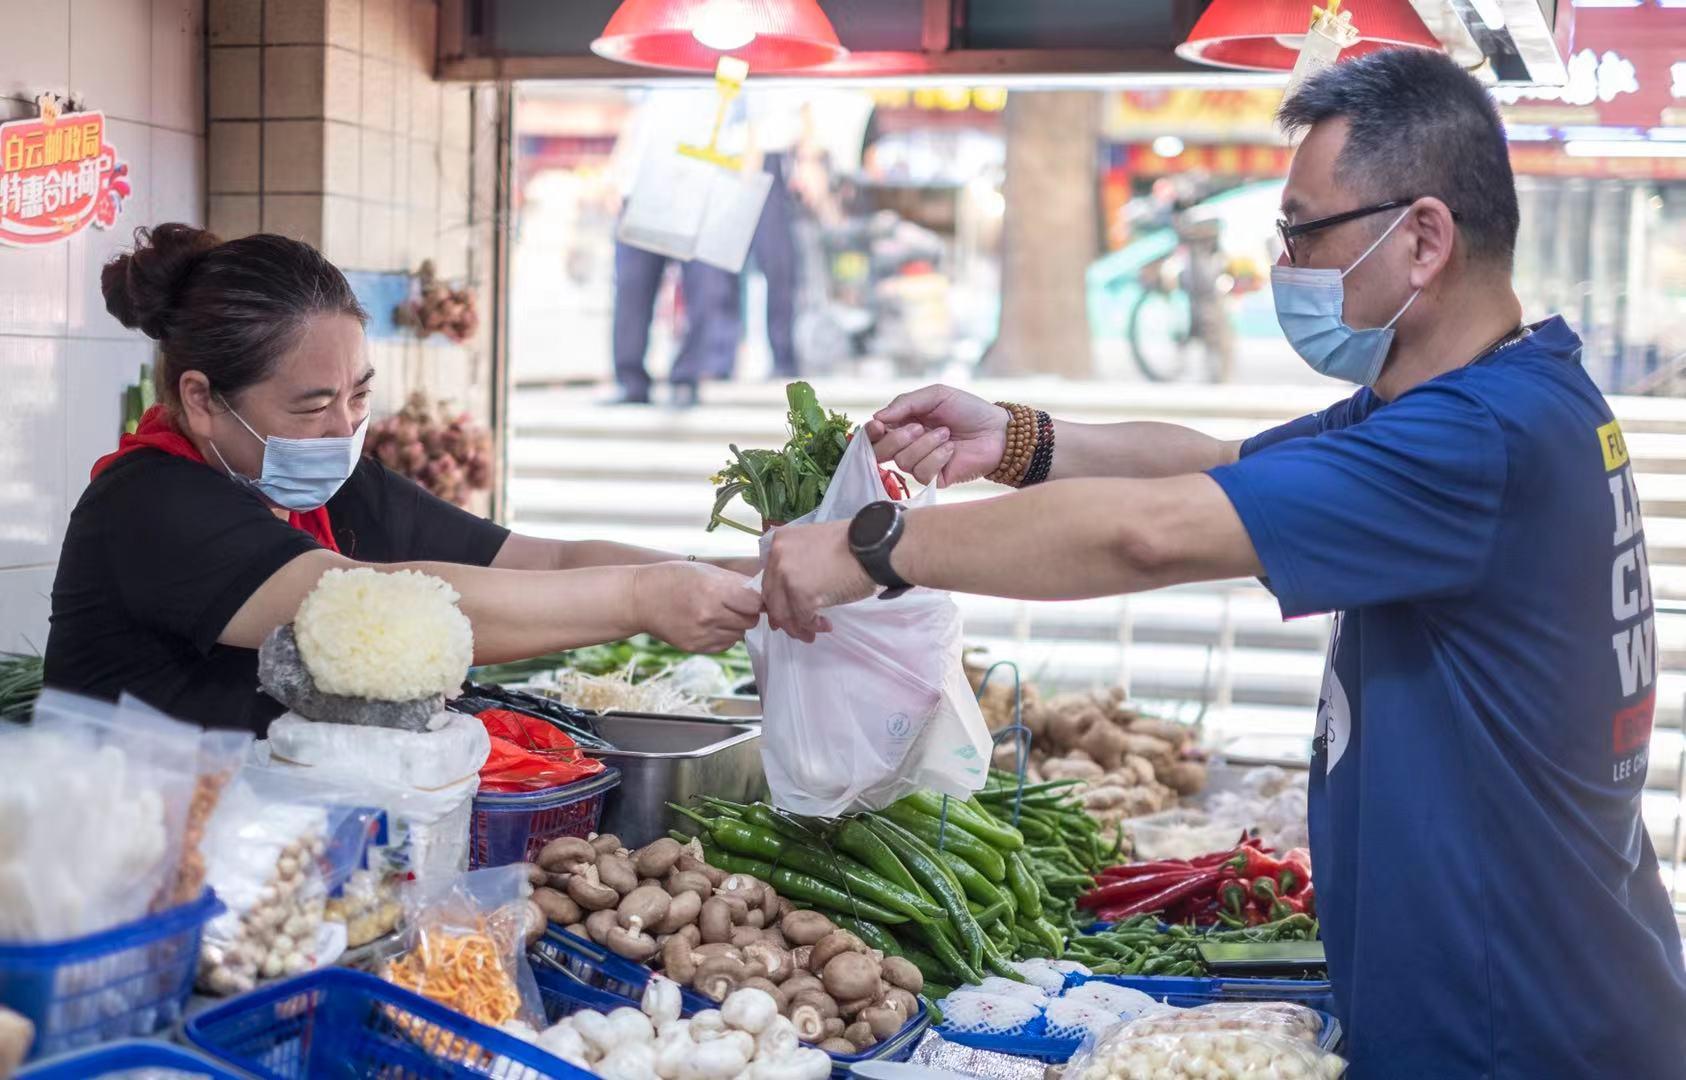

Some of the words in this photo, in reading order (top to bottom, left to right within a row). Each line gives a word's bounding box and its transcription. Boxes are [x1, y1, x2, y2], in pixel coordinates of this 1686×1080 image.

[5, 122, 100, 173] 白云邮政局
[0, 153, 113, 219] 特惠合作商户
[1613, 758, 1632, 783] LEE
